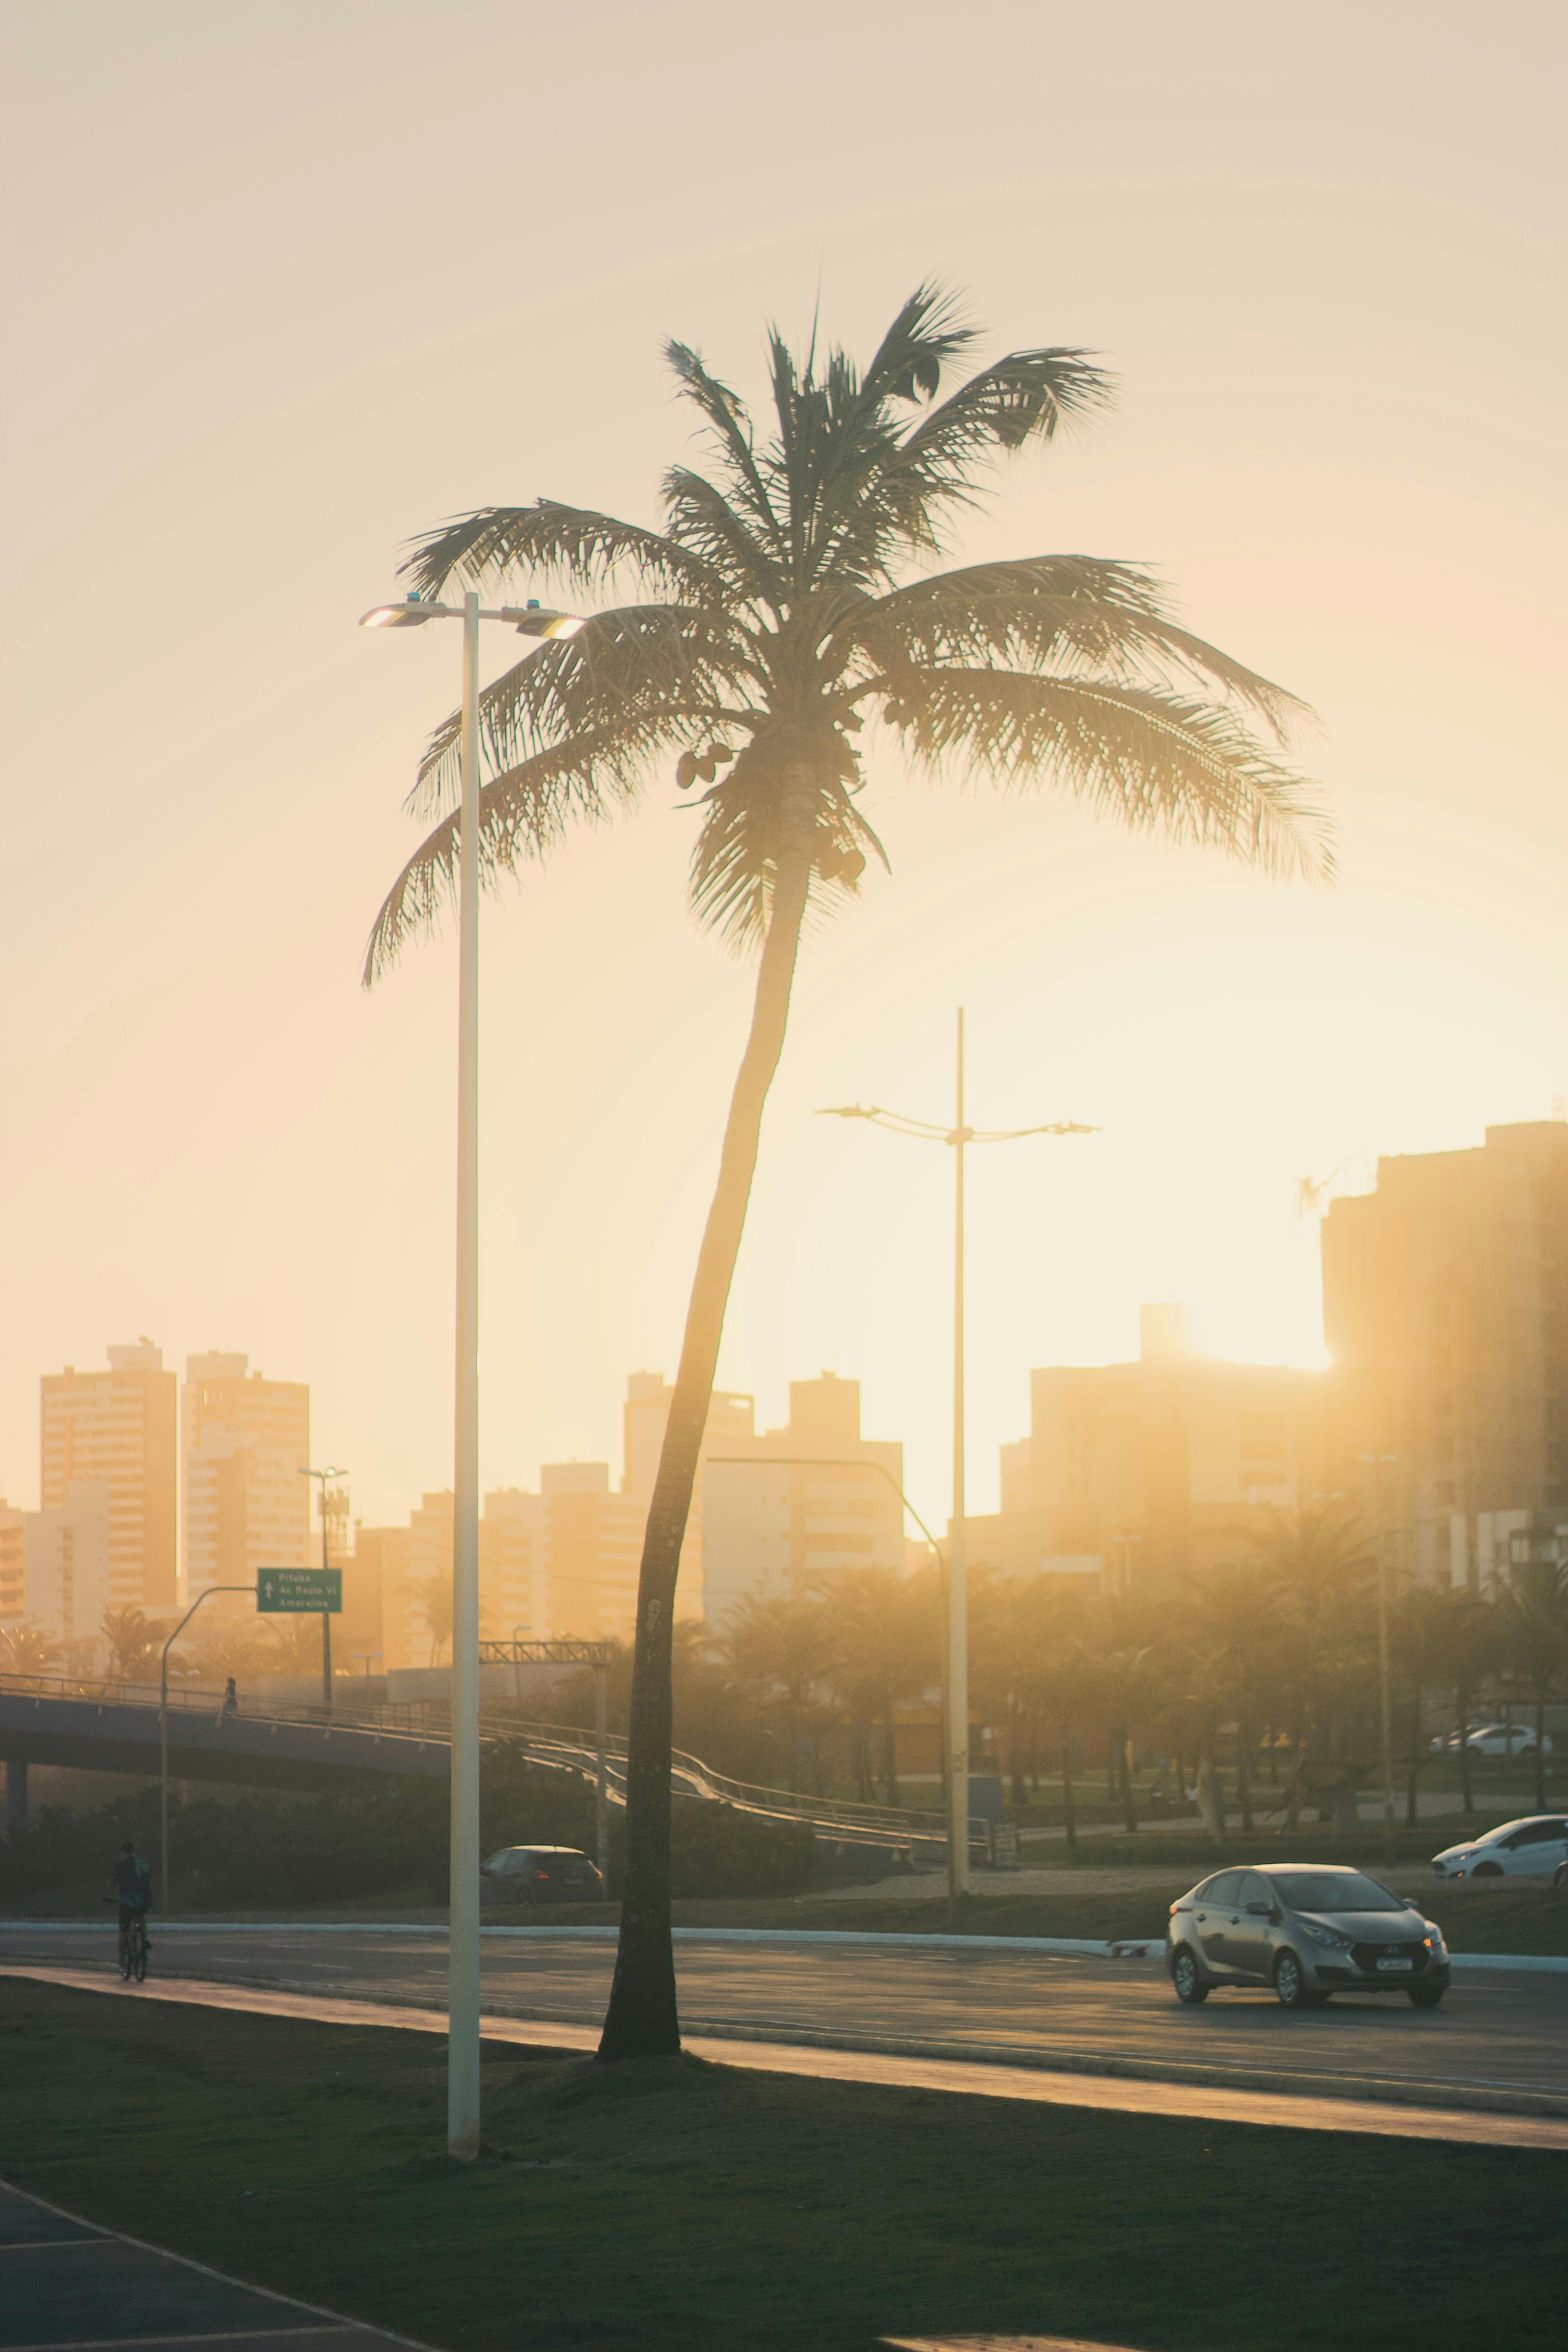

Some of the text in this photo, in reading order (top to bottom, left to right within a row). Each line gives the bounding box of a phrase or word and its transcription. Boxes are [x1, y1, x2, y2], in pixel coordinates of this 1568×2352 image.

[279, 1573, 310, 1582] Pituba
[296, 1585, 322, 1594] Paulo
[279, 1599, 328, 1607] Amaralina
